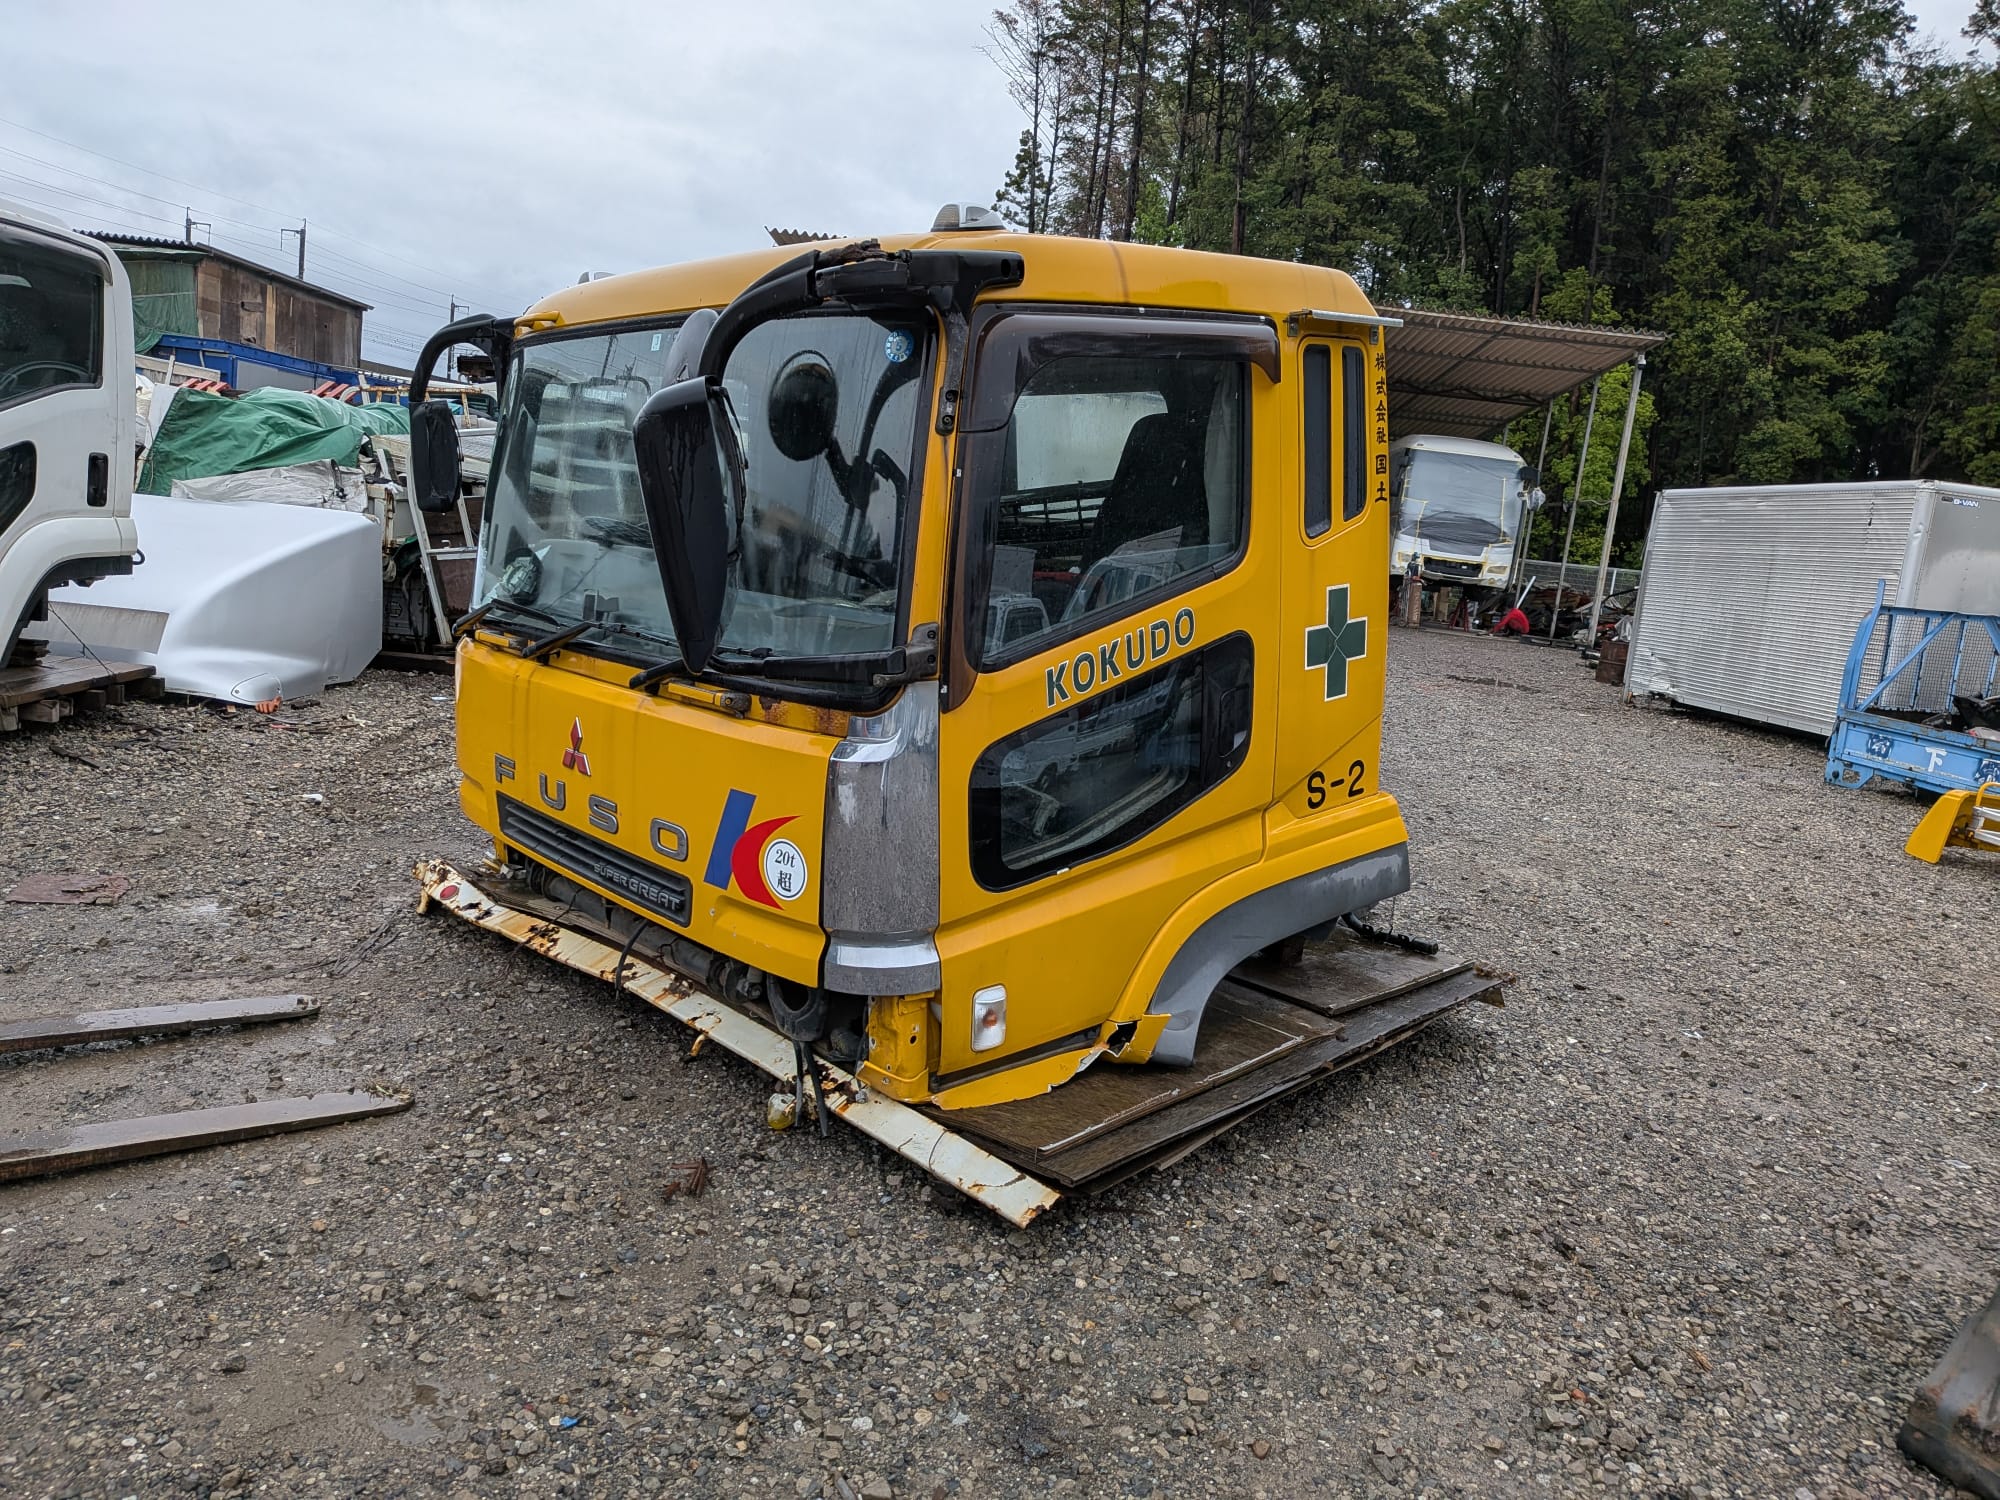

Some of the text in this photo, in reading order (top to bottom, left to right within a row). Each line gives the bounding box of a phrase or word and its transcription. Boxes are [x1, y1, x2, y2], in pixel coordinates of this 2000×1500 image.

[1045, 606, 1196, 709] KOKUDO
[1925, 746, 1948, 772] 下
[1307, 759, 1365, 810] S-2
[494, 752, 689, 862] FUSO
[774, 848, 797, 868] 20t
[776, 870, 792, 893] 超
